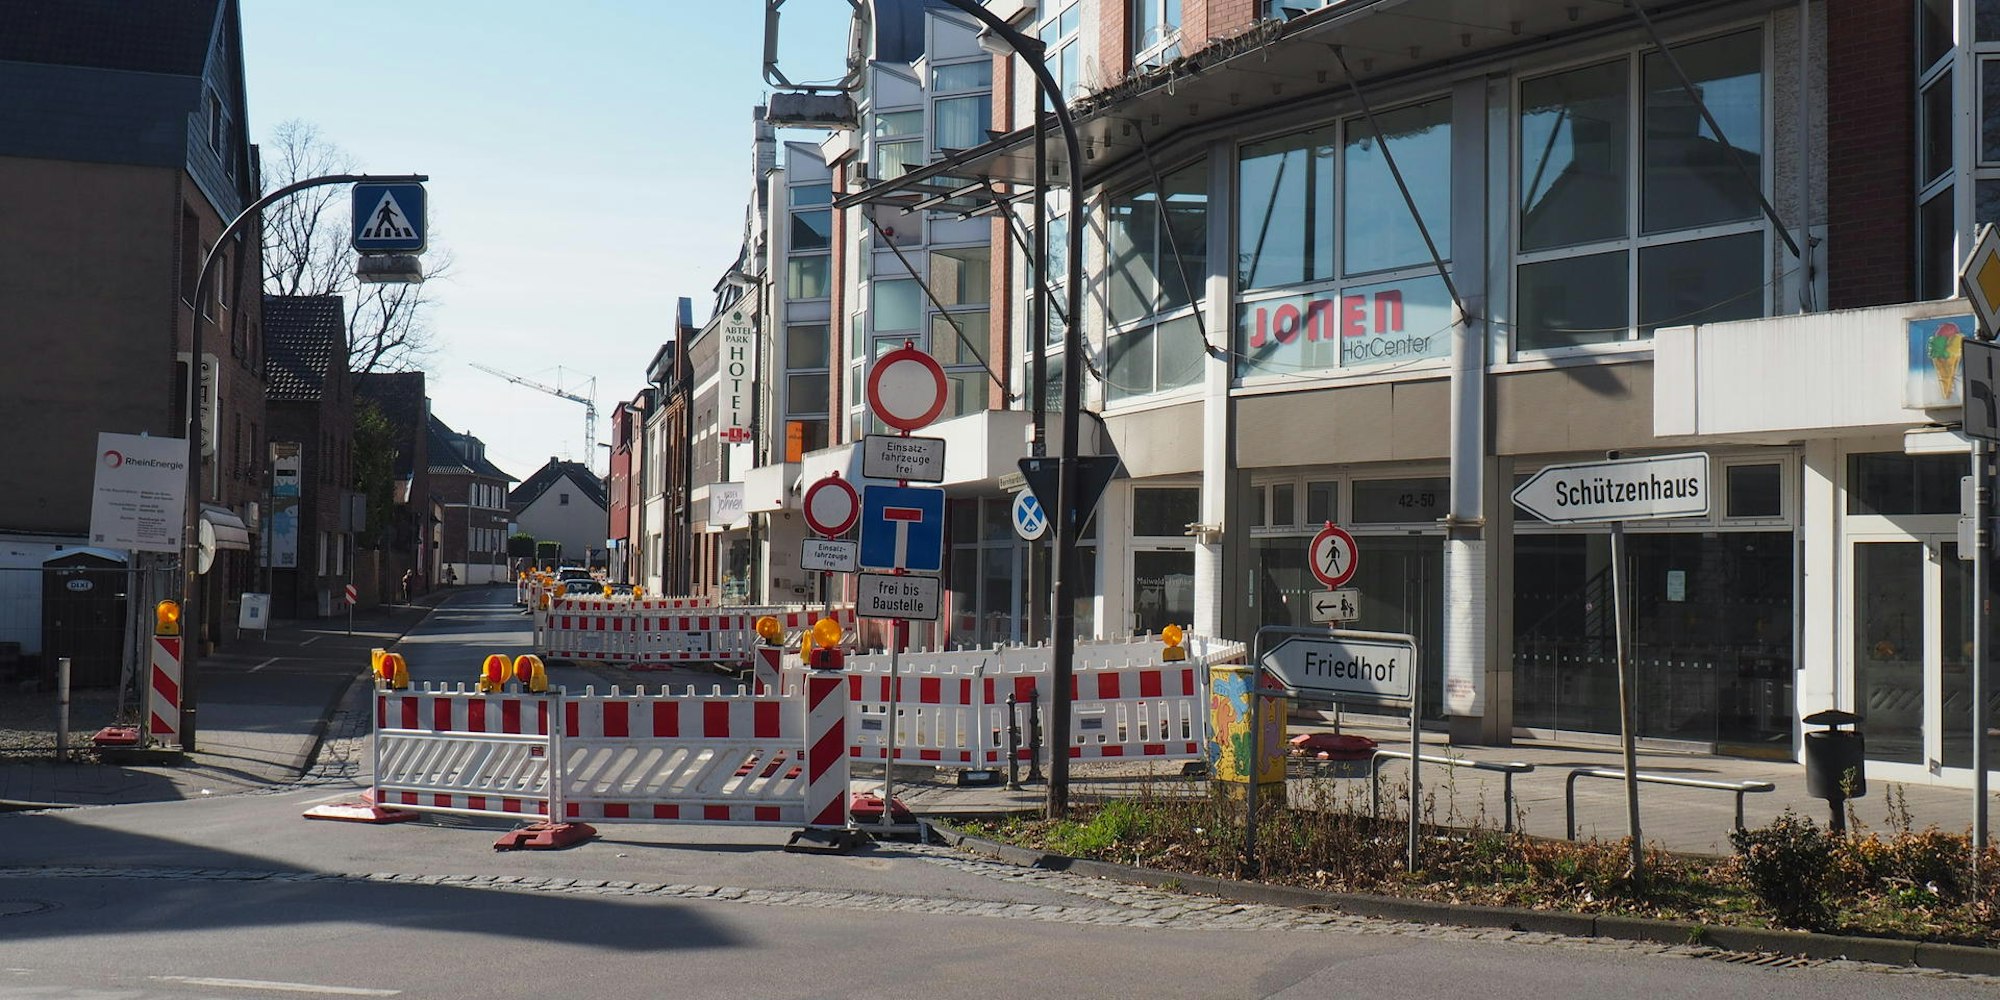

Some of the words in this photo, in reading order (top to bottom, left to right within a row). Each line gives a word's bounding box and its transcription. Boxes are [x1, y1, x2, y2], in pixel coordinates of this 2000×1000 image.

[725, 327, 751, 335] ABTEI
[726, 335, 749, 344] PARK
[1342, 334, 1430, 361] HörCenter
[729, 346, 745, 426] HOTEL
[887, 442, 927, 453] Einsatz-
[125, 457, 184, 470] RheinEnergie
[881, 452, 930, 465] fahrzeuge
[896, 465, 913, 473] frei
[1556, 473, 1699, 507] Schützenhaus
[1399, 493, 1435, 508] 42-50
[818, 544, 847, 552] Einsatz-
[814, 552, 848, 561] fahrzeuge
[879, 581, 898, 595] frei
[903, 582, 919, 596] bis
[873, 596, 924, 612] Baustelle
[1304, 651, 1396, 682] Friedhof
